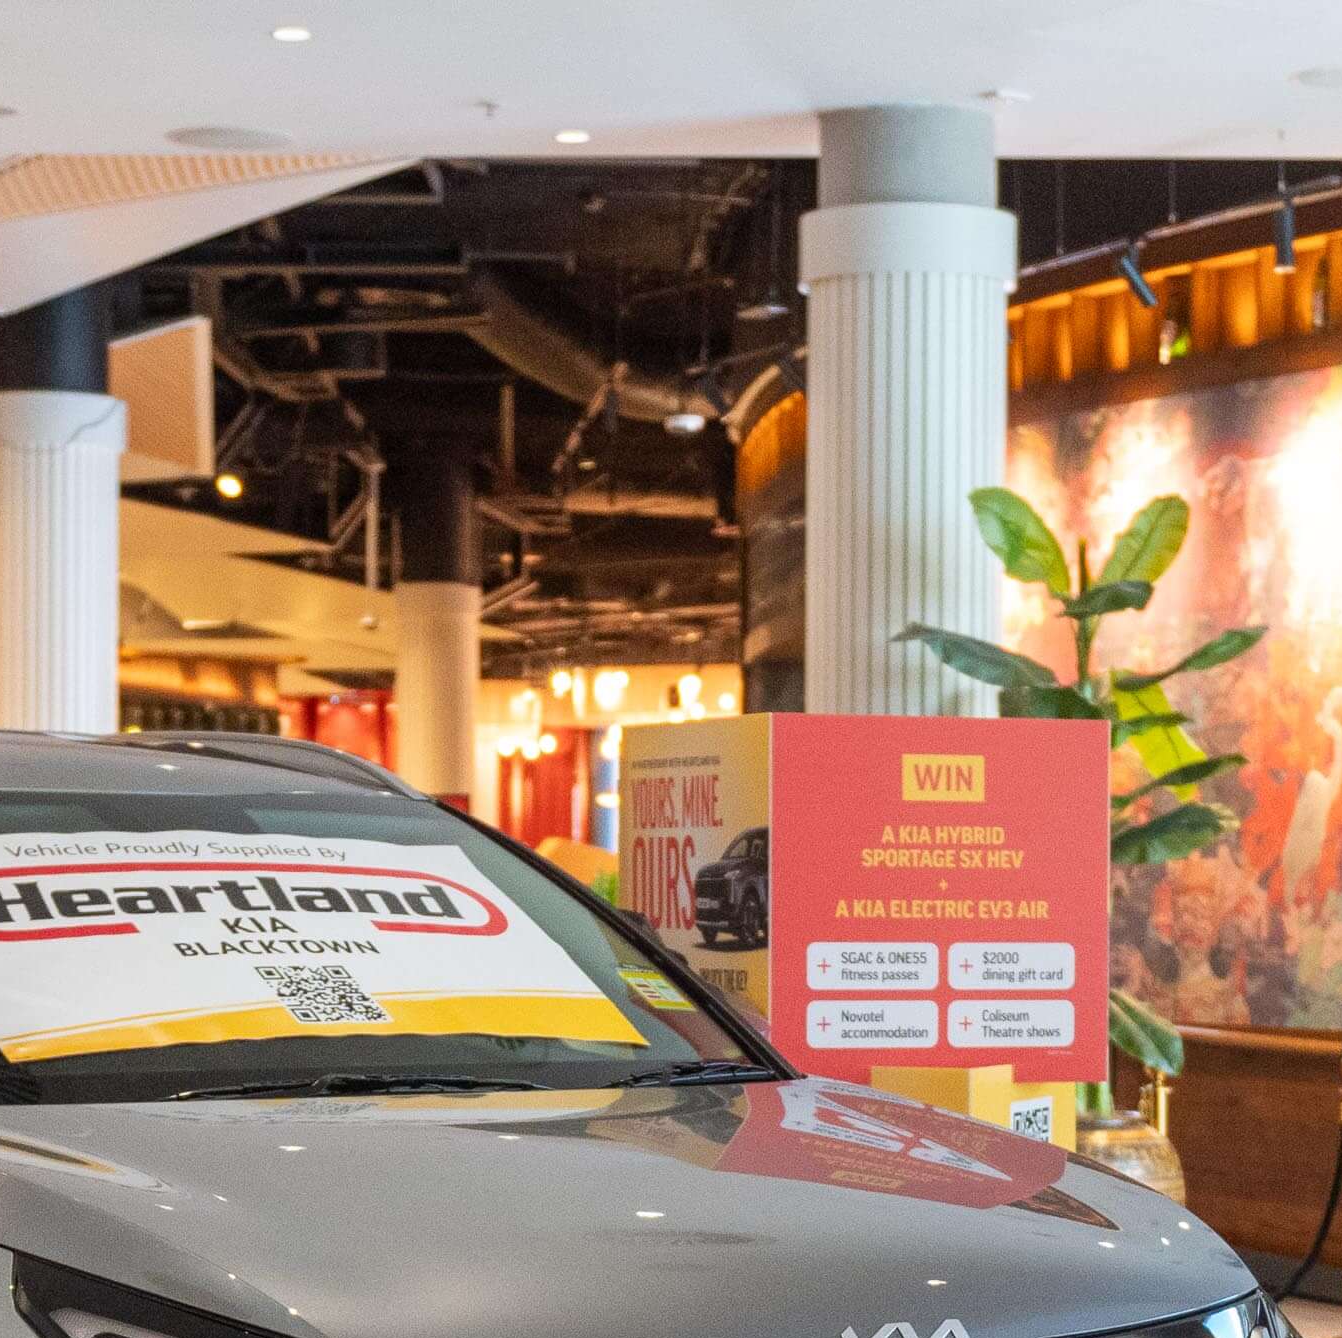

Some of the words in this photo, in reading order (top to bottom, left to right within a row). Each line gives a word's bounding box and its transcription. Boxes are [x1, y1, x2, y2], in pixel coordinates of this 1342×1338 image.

[914, 764, 973, 791] WIN
[682, 774, 723, 828] MINE.
[882, 825, 895, 844] A
[899, 826, 931, 844] KIA
[935, 826, 1005, 845] HYBRID
[4, 843, 97, 858] Vehicle
[106, 841, 199, 858] Proudly
[208, 842, 309, 860] Supplied
[319, 847, 346, 861] By
[862, 849, 956, 868] SPORTAGE
[959, 850, 982, 868] SX
[987, 850, 1024, 868] HEV
[632, 835, 696, 929] OURS
[835, 900, 849, 918] A
[853, 900, 886, 918] KIA
[890, 900, 975, 919] ELECTRIC
[978, 900, 1013, 919] EV3
[1016, 900, 1049, 919] AIR
[220, 917, 298, 935] KIA
[174, 940, 380, 957] BLACKTOWN
[841, 952, 873, 964] SGAC
[876, 952, 884, 964] &
[889, 952, 927, 964] ONE55
[982, 951, 1019, 965] $2000
[841, 969, 878, 981] fitness
[882, 970, 919, 982] passes
[982, 969, 1015, 982] dining
[1018, 969, 1036, 982] gift
[1040, 969, 1064, 981] card
[841, 1010, 884, 1022] Novotel
[982, 1009, 1030, 1022] Coliseum
[841, 1027, 928, 1039] accommodation
[982, 1026, 1024, 1038] Theatre
[1027, 1026, 1060, 1038] shows
